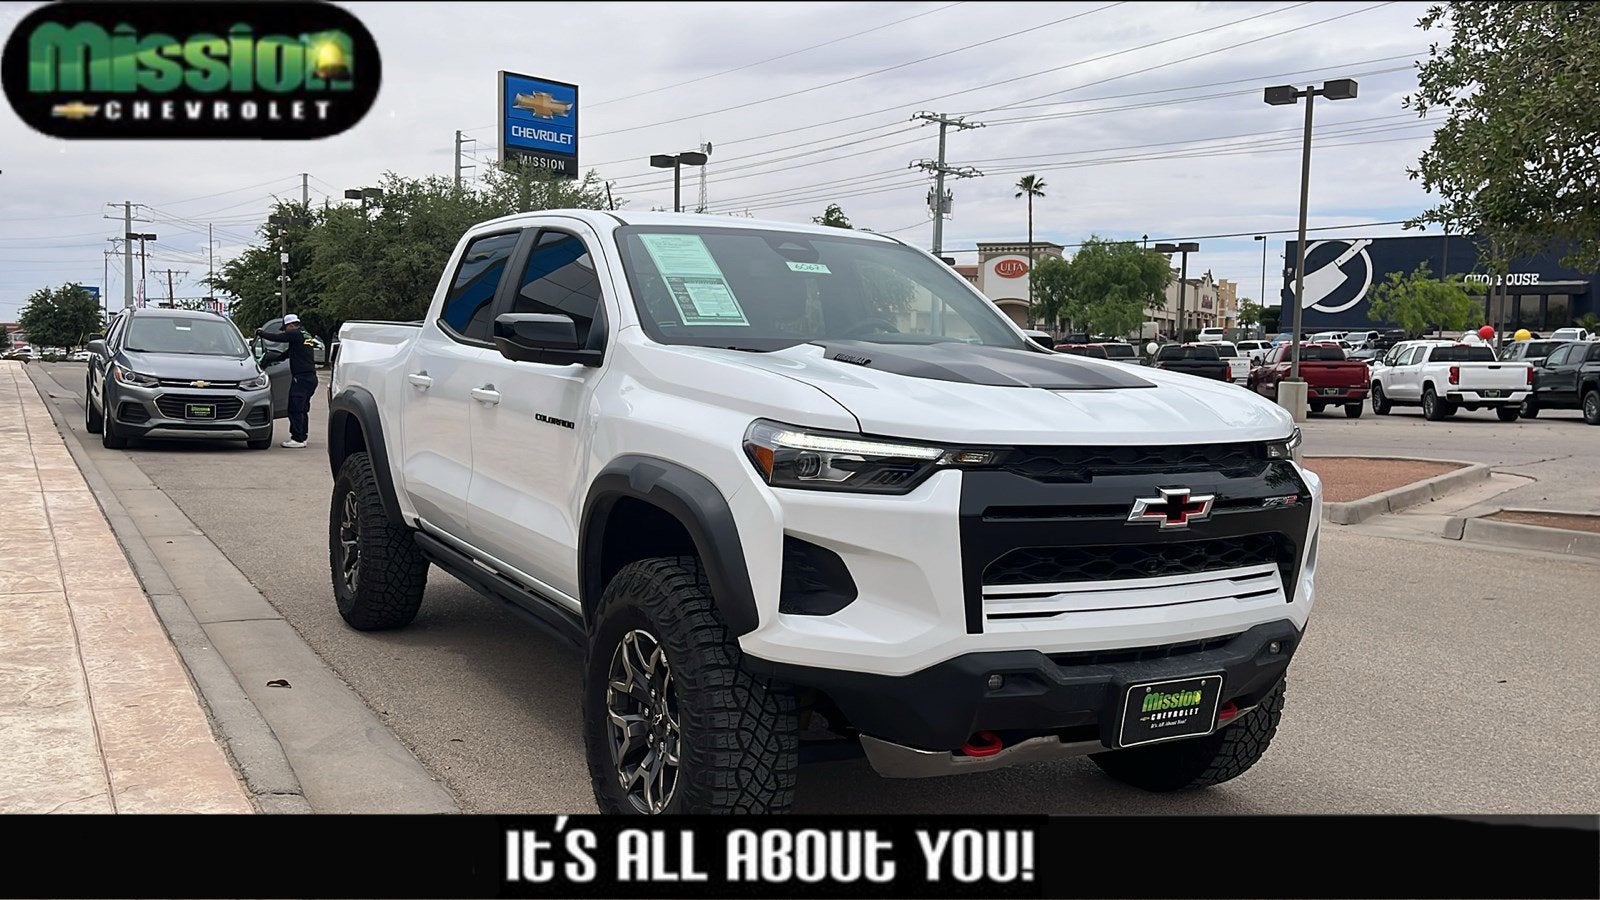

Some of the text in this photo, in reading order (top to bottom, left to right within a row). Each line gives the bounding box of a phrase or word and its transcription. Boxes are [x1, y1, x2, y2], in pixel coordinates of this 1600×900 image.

[511, 125, 573, 145] CHEVROLET
[519, 153, 565, 170] MISSION
[1000, 262, 1024, 272] ULTA
[535, 413, 575, 429] COLORADO
[1142, 690, 1202, 712] Mission
[1150, 708, 1199, 720] CHEVROLET
